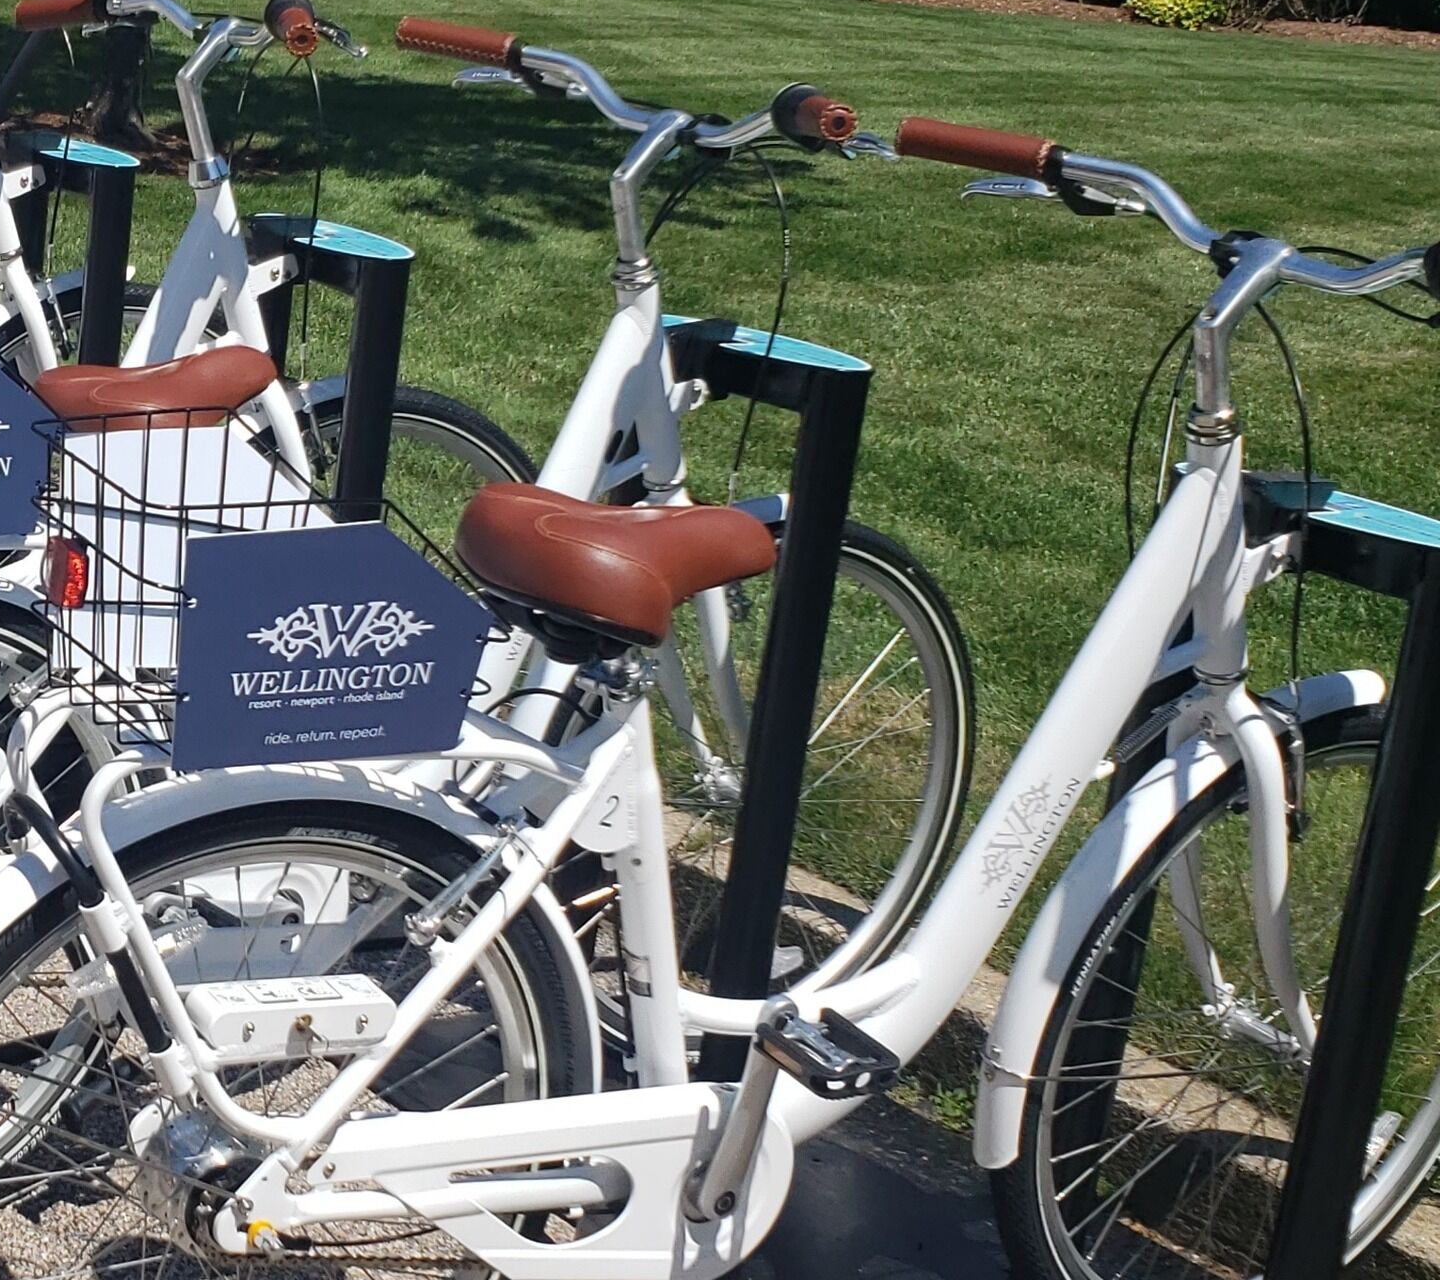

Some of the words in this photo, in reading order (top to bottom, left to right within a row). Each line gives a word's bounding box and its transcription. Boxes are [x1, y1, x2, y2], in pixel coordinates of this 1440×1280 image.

[230, 661, 435, 697] WELLINGTON
[248, 697, 282, 709] resort
[290, 695, 335, 708] newport
[343, 691, 374, 704] rhode
[375, 689, 404, 702] island
[263, 731, 294, 745] ride.
[295, 729, 337, 744] return.
[339, 725, 387, 741] repeat.
[599, 794, 621, 828] 2
[996, 776, 1082, 910] WELLINGTON
